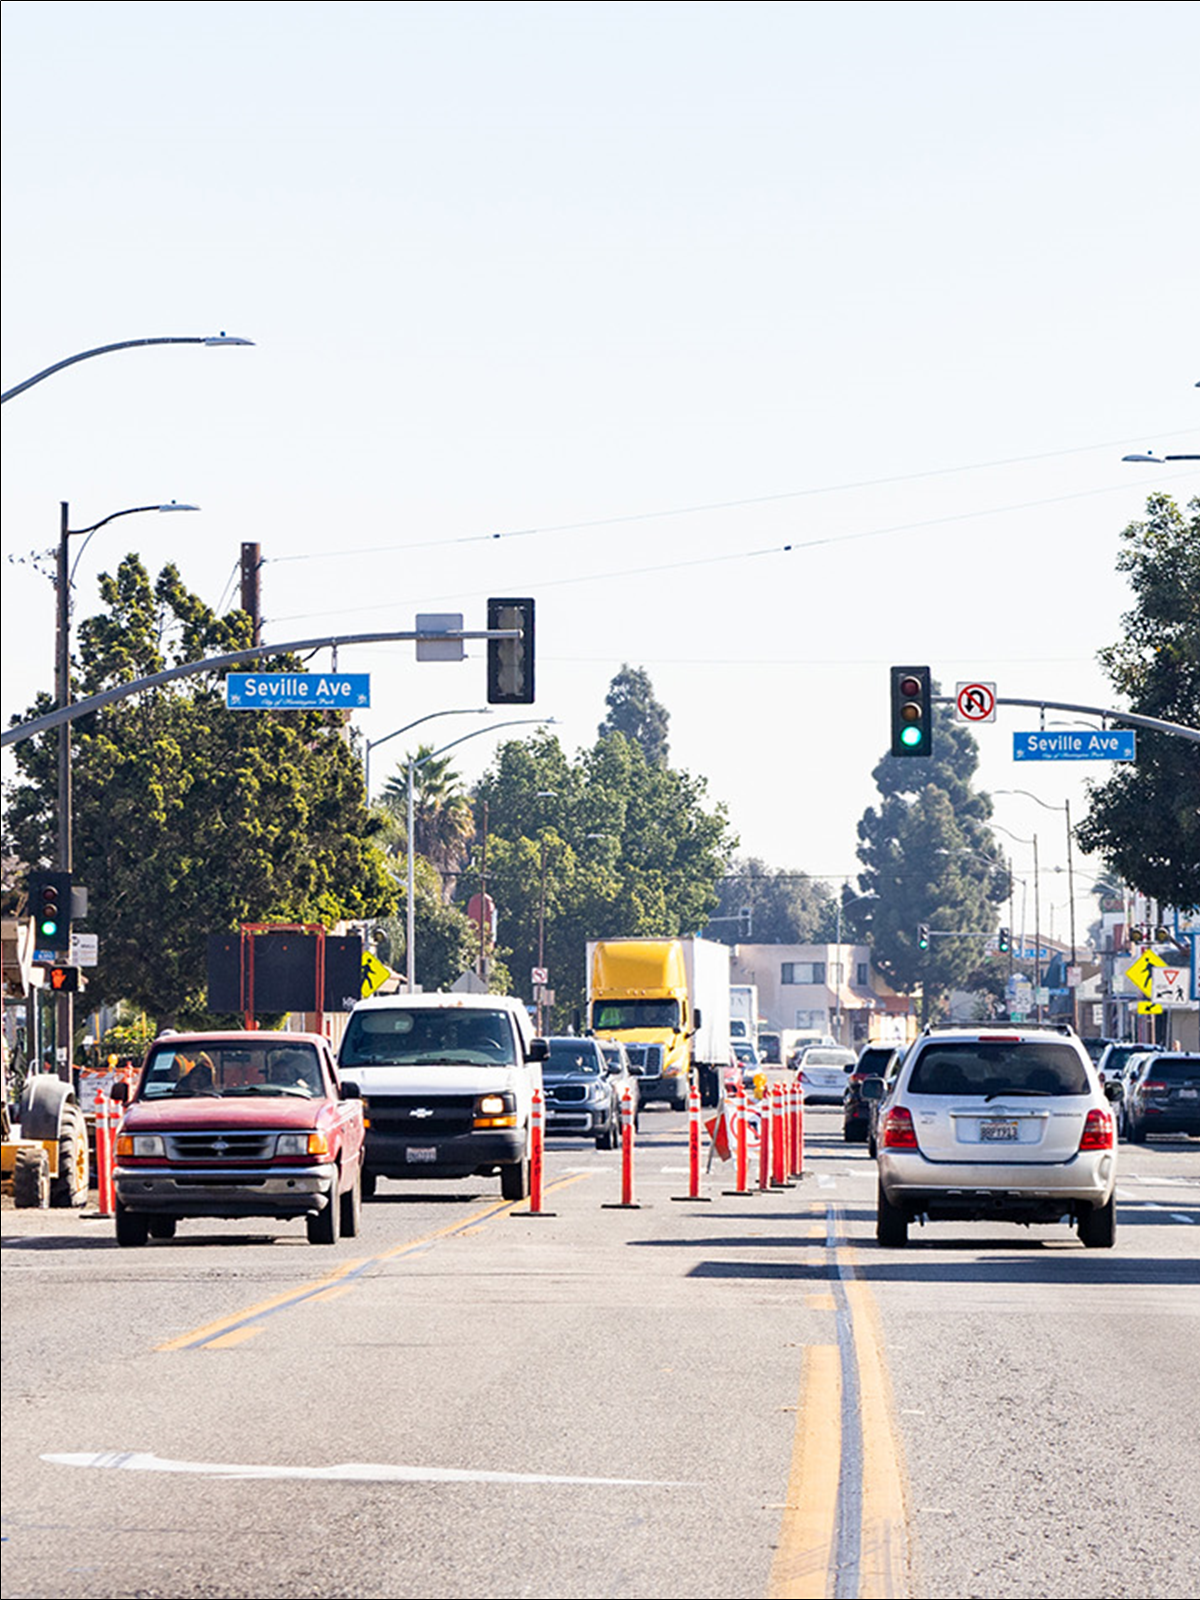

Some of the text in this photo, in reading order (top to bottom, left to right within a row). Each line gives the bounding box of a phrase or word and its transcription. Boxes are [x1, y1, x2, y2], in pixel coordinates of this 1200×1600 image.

[245, 678, 352, 696] Seville Ave
[1027, 735, 1119, 751] Seville Ave
